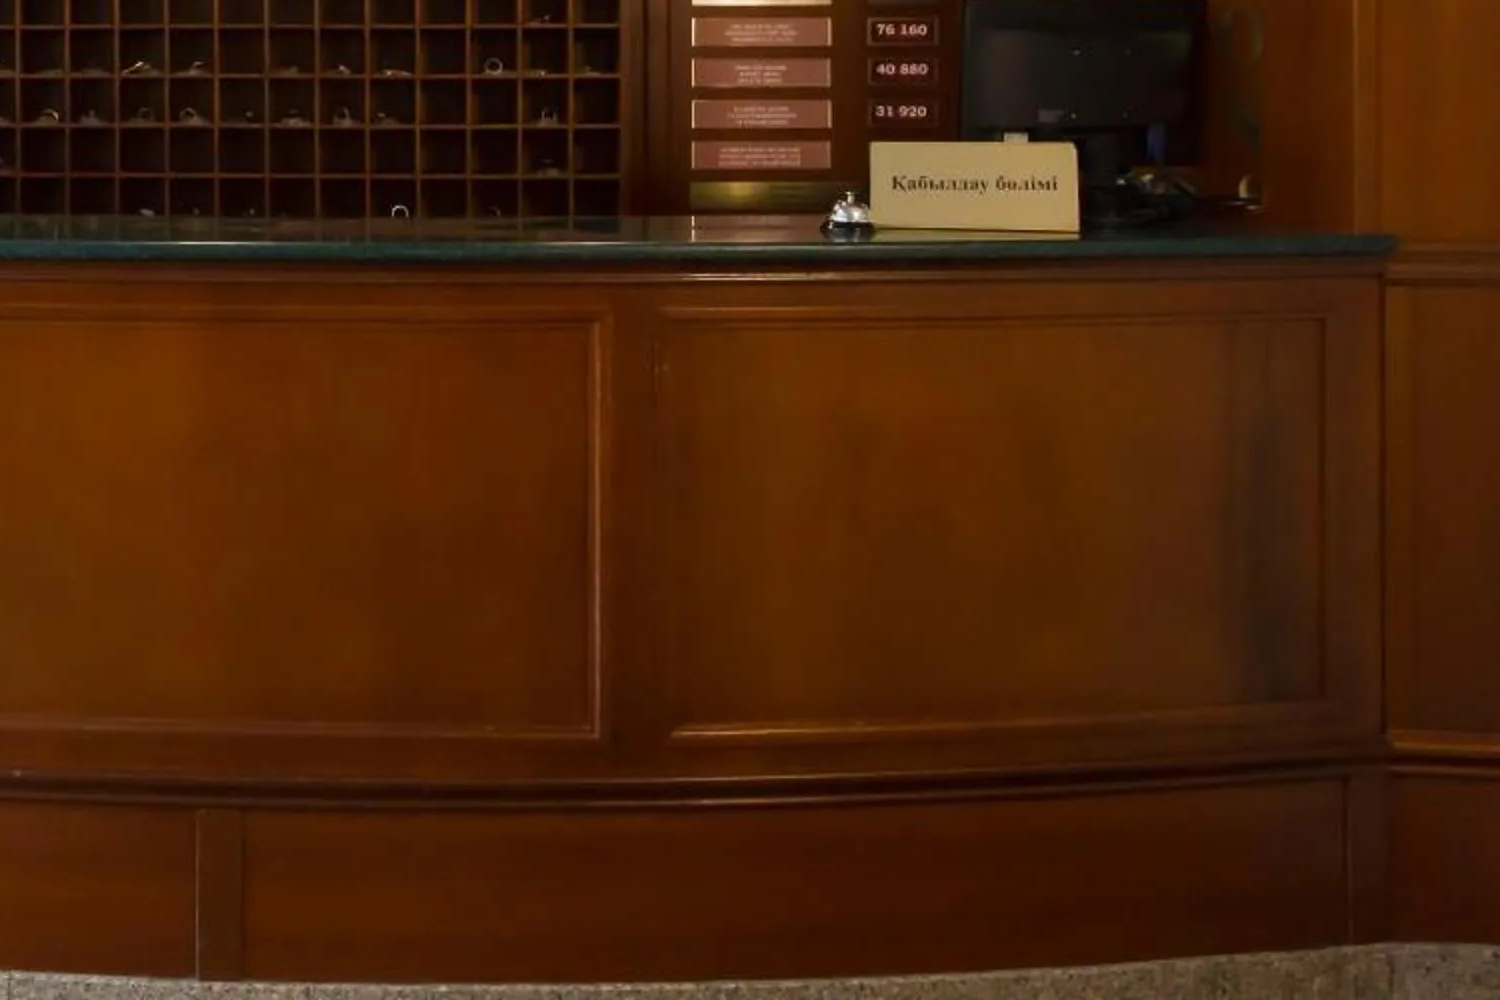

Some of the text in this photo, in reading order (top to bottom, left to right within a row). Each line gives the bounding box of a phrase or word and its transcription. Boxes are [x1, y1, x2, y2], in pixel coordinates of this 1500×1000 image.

[875, 23, 929, 36] 76 160
[875, 63, 896, 76] 40
[875, 104, 928, 118] 31 920
